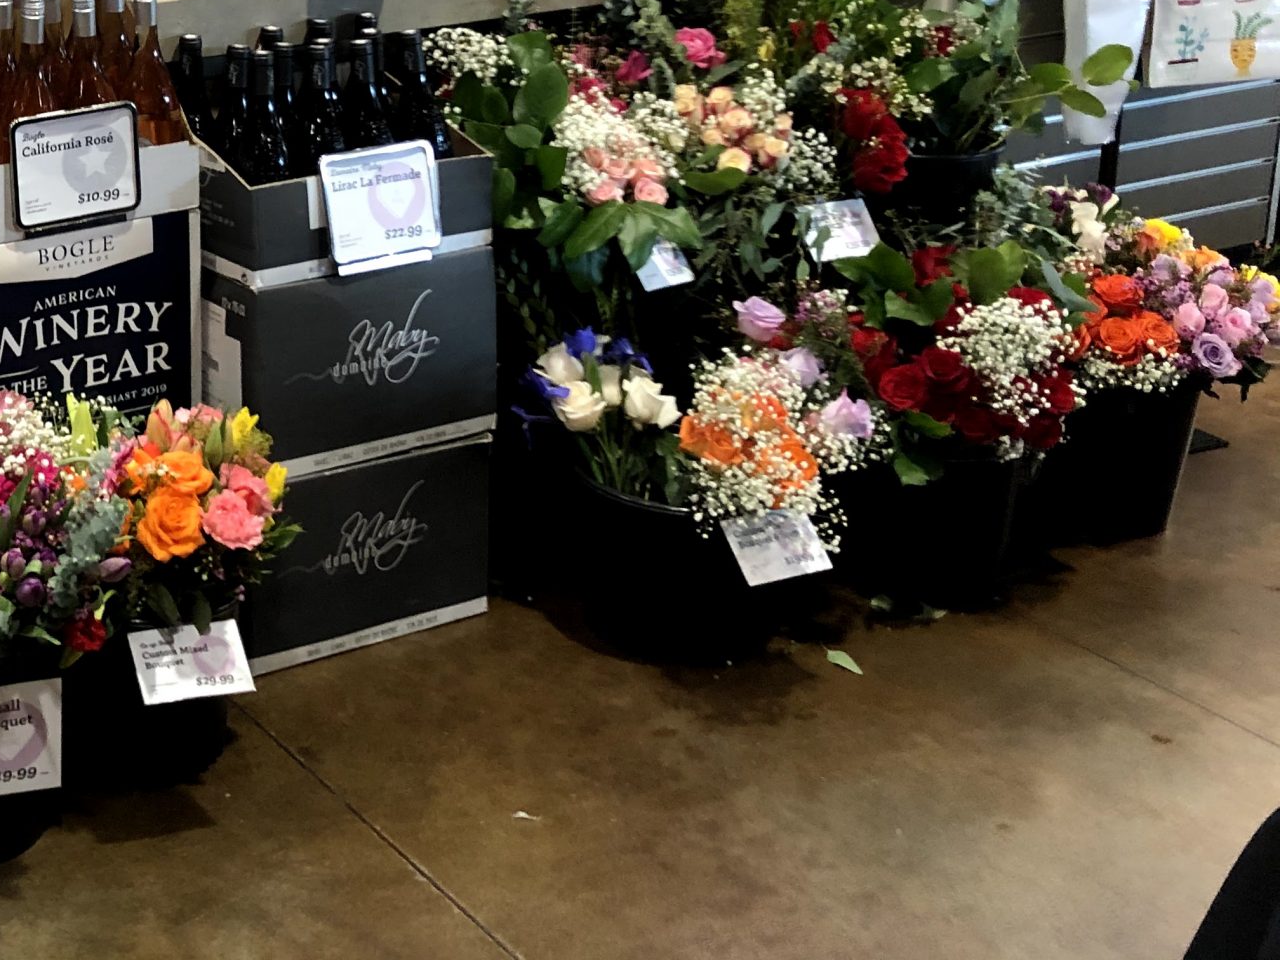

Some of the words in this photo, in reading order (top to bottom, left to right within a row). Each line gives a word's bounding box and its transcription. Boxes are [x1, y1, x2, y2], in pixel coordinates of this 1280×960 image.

[22, 131, 46, 142] Bogle
[22, 138, 82, 158] California
[85, 132, 114, 147] Rosé
[332, 180, 358, 192] Lirac
[360, 177, 373, 188] La
[375, 168, 421, 185] Fermade
[78, 188, 120, 204] $10.99
[384, 225, 423, 240] $22.99
[38, 234, 115, 266] BOGLE
[45, 255, 110, 272] VINEYARDS
[33, 285, 117, 313] AMERICAN
[11, 375, 48, 396] THE
[50, 342, 172, 393] YEAR
[106, 390, 138, 405] SIAST
[141, 384, 167, 398] 2019
[142, 647, 177, 660] Custom
[180, 643, 209, 654] Mixed
[145, 658, 184, 670] Bouquet
[196, 674, 234, 687] $29.99
